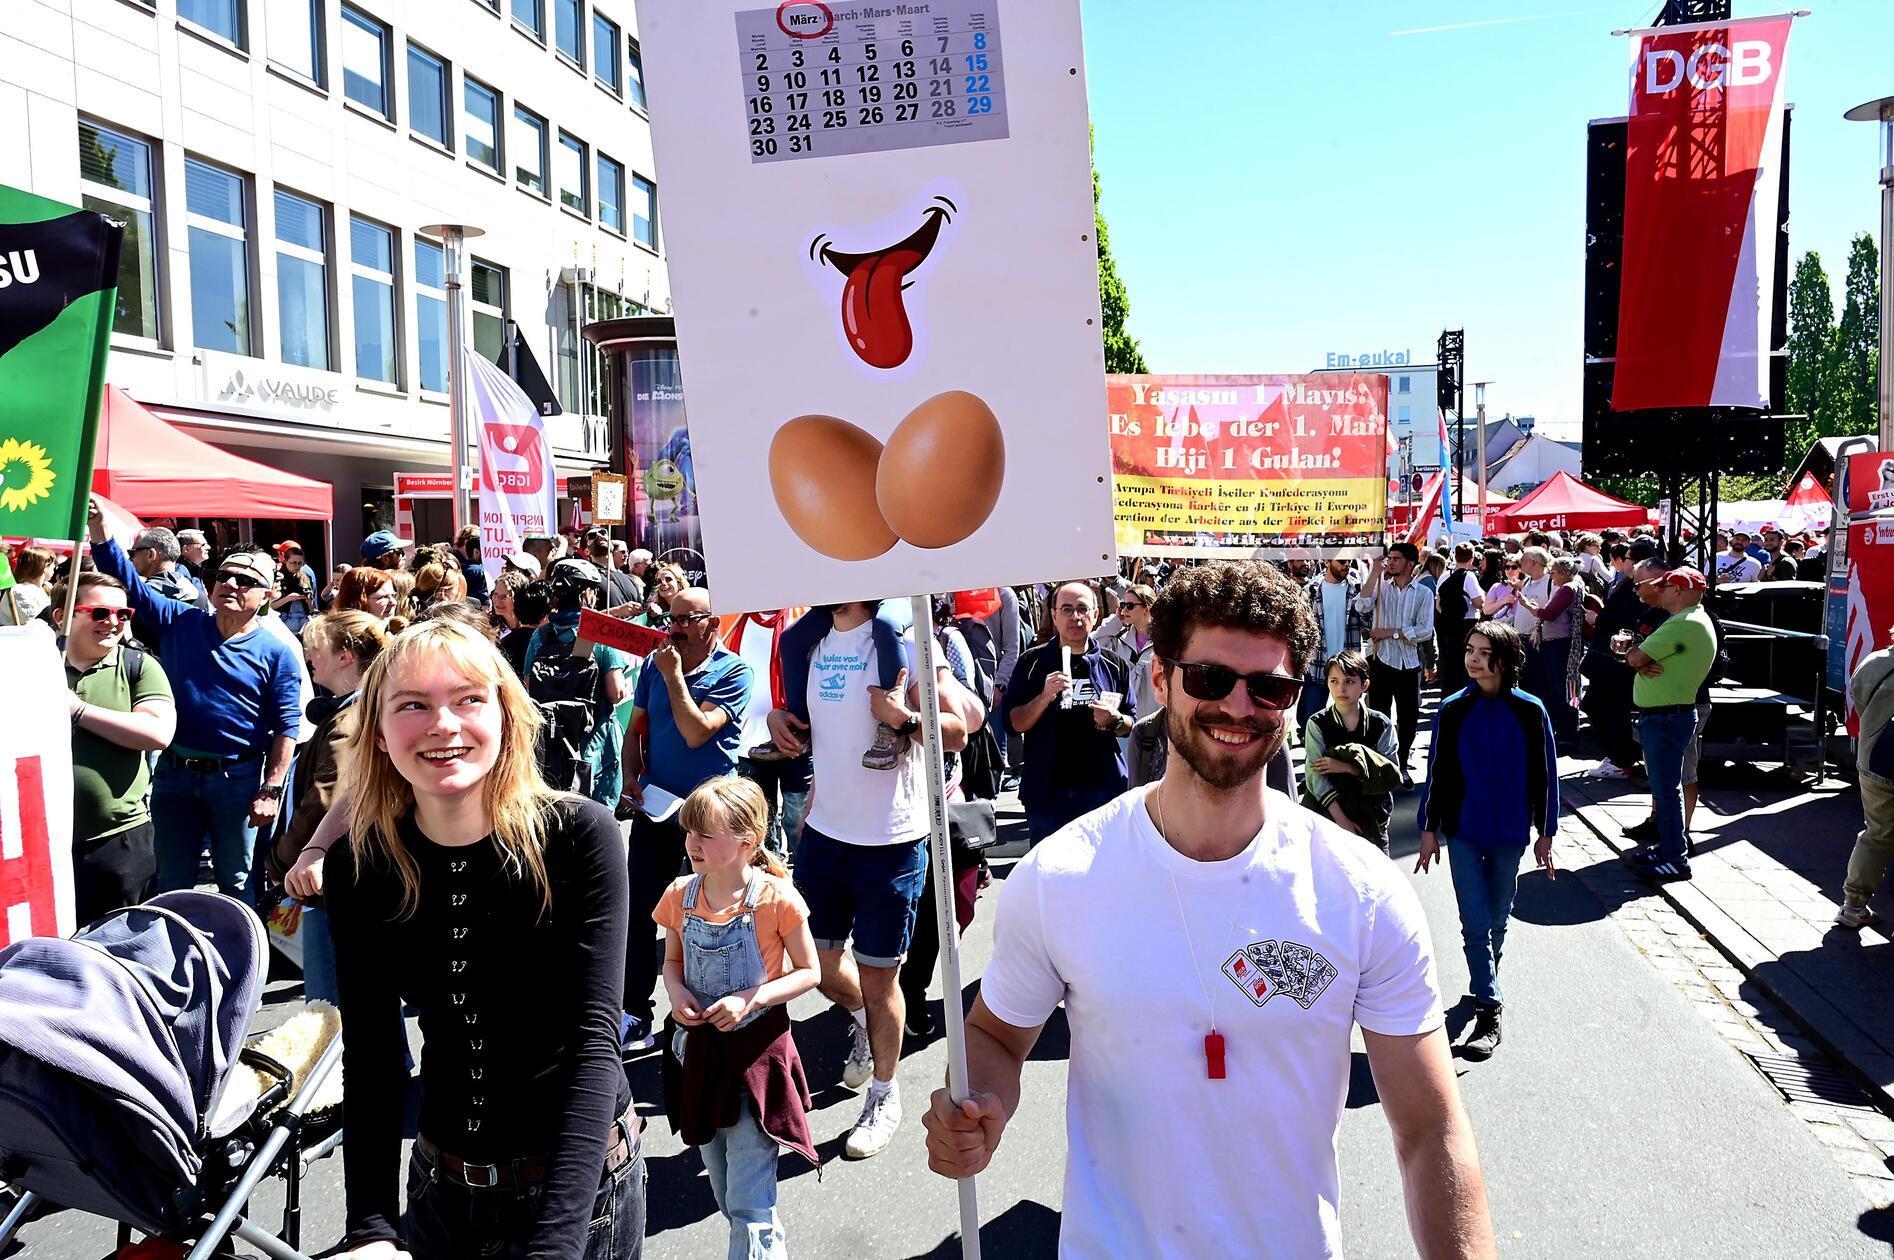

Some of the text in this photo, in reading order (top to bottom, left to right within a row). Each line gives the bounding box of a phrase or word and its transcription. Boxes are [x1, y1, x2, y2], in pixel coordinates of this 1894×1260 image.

[756, 32, 987, 72] 2 3 4 5 6 7 8
[757, 53, 988, 92] 9 10 11 12 13 14 15
[1646, 40, 1772, 94] DGB
[749, 74, 990, 114] 16 17 18 19 20 21 22
[749, 95, 992, 135] 23 24 25 26 27 28 29
[752, 134, 812, 157] 30 31
[1327, 349, 1410, 368] Em-eukal
[265, 378, 340, 404] VAUDE
[1110, 413, 1385, 437] Es lebe der 1. Mai!
[1221, 447, 1236, 469] 1
[1251, 446, 1342, 469] Gulan!
[1185, 515, 1235, 526] Arbeiter
